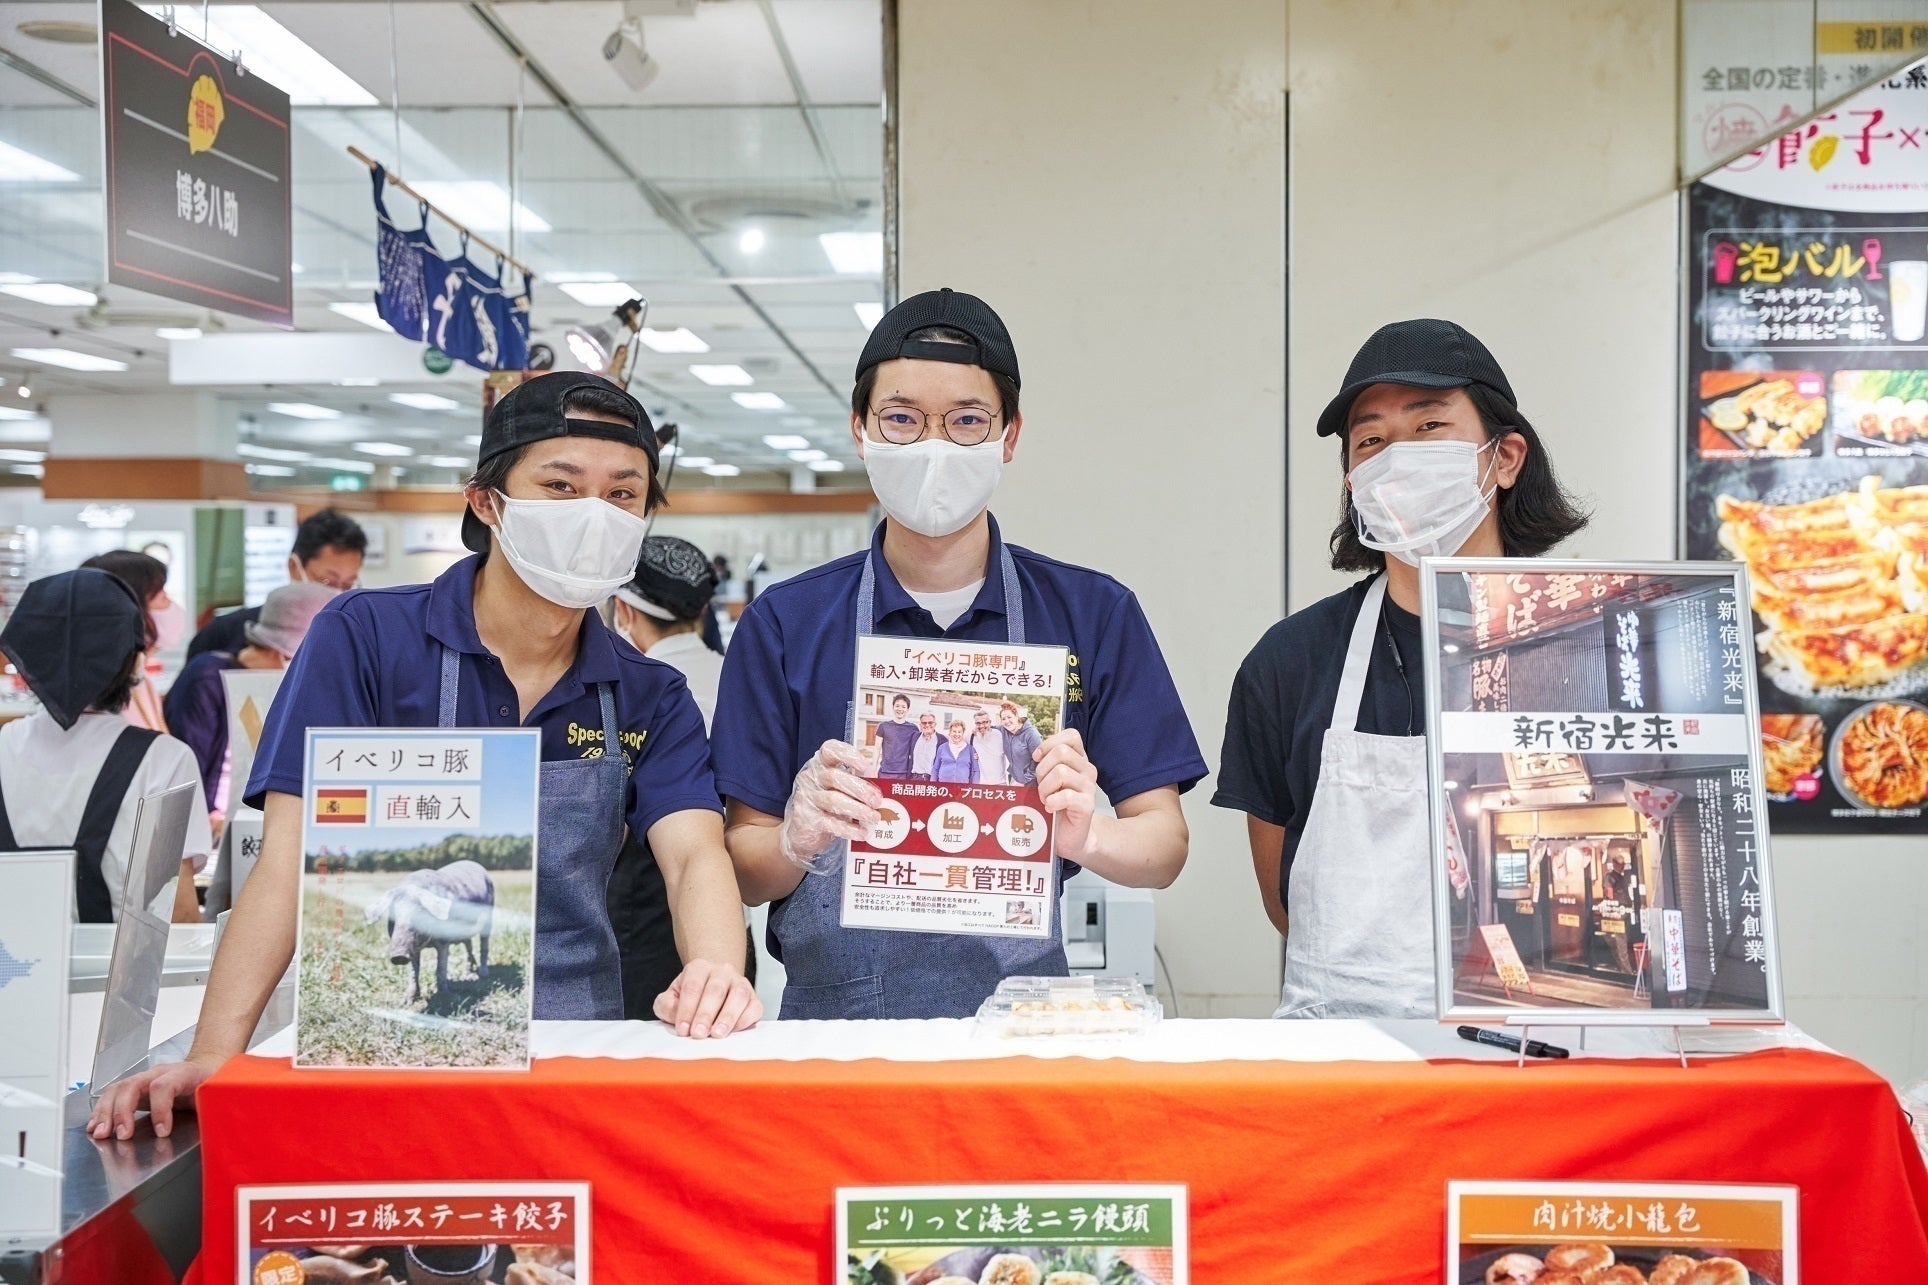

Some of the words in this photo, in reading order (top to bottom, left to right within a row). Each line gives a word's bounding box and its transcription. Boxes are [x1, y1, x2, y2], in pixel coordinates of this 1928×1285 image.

[176, 169, 239, 238] 博多八助
[1736, 241, 1867, 283] 泡バル
[1739, 287, 1863, 304] ビールやサワーから
[1716, 587, 1744, 705] 『新宿光来』
[903, 648, 1026, 671] 『イベリコ豚専門』
[870, 663, 1052, 688] 輸入・卸業者だからできる!
[1513, 714, 1678, 752] 新宿光来
[325, 748, 469, 773] イベリコ豚
[891, 783, 1017, 801] 商品開発の、プロセスを
[386, 794, 471, 820] 直輸入
[874, 829, 894, 840] 育成
[942, 833, 962, 844] 加工
[1011, 836, 1031, 848] 販売
[854, 858, 1045, 895] 『自社一貫管理!』
[1730, 768, 1767, 974] 昭和二十八年創業。
[259, 1201, 568, 1232] イベリコ豚ステーキ餃子
[866, 1202, 1151, 1233] ぷりっと海老ニラ饅頭
[1533, 1199, 1701, 1234] 肉汁焼小籠包
[259, 1265, 298, 1285] 限定
